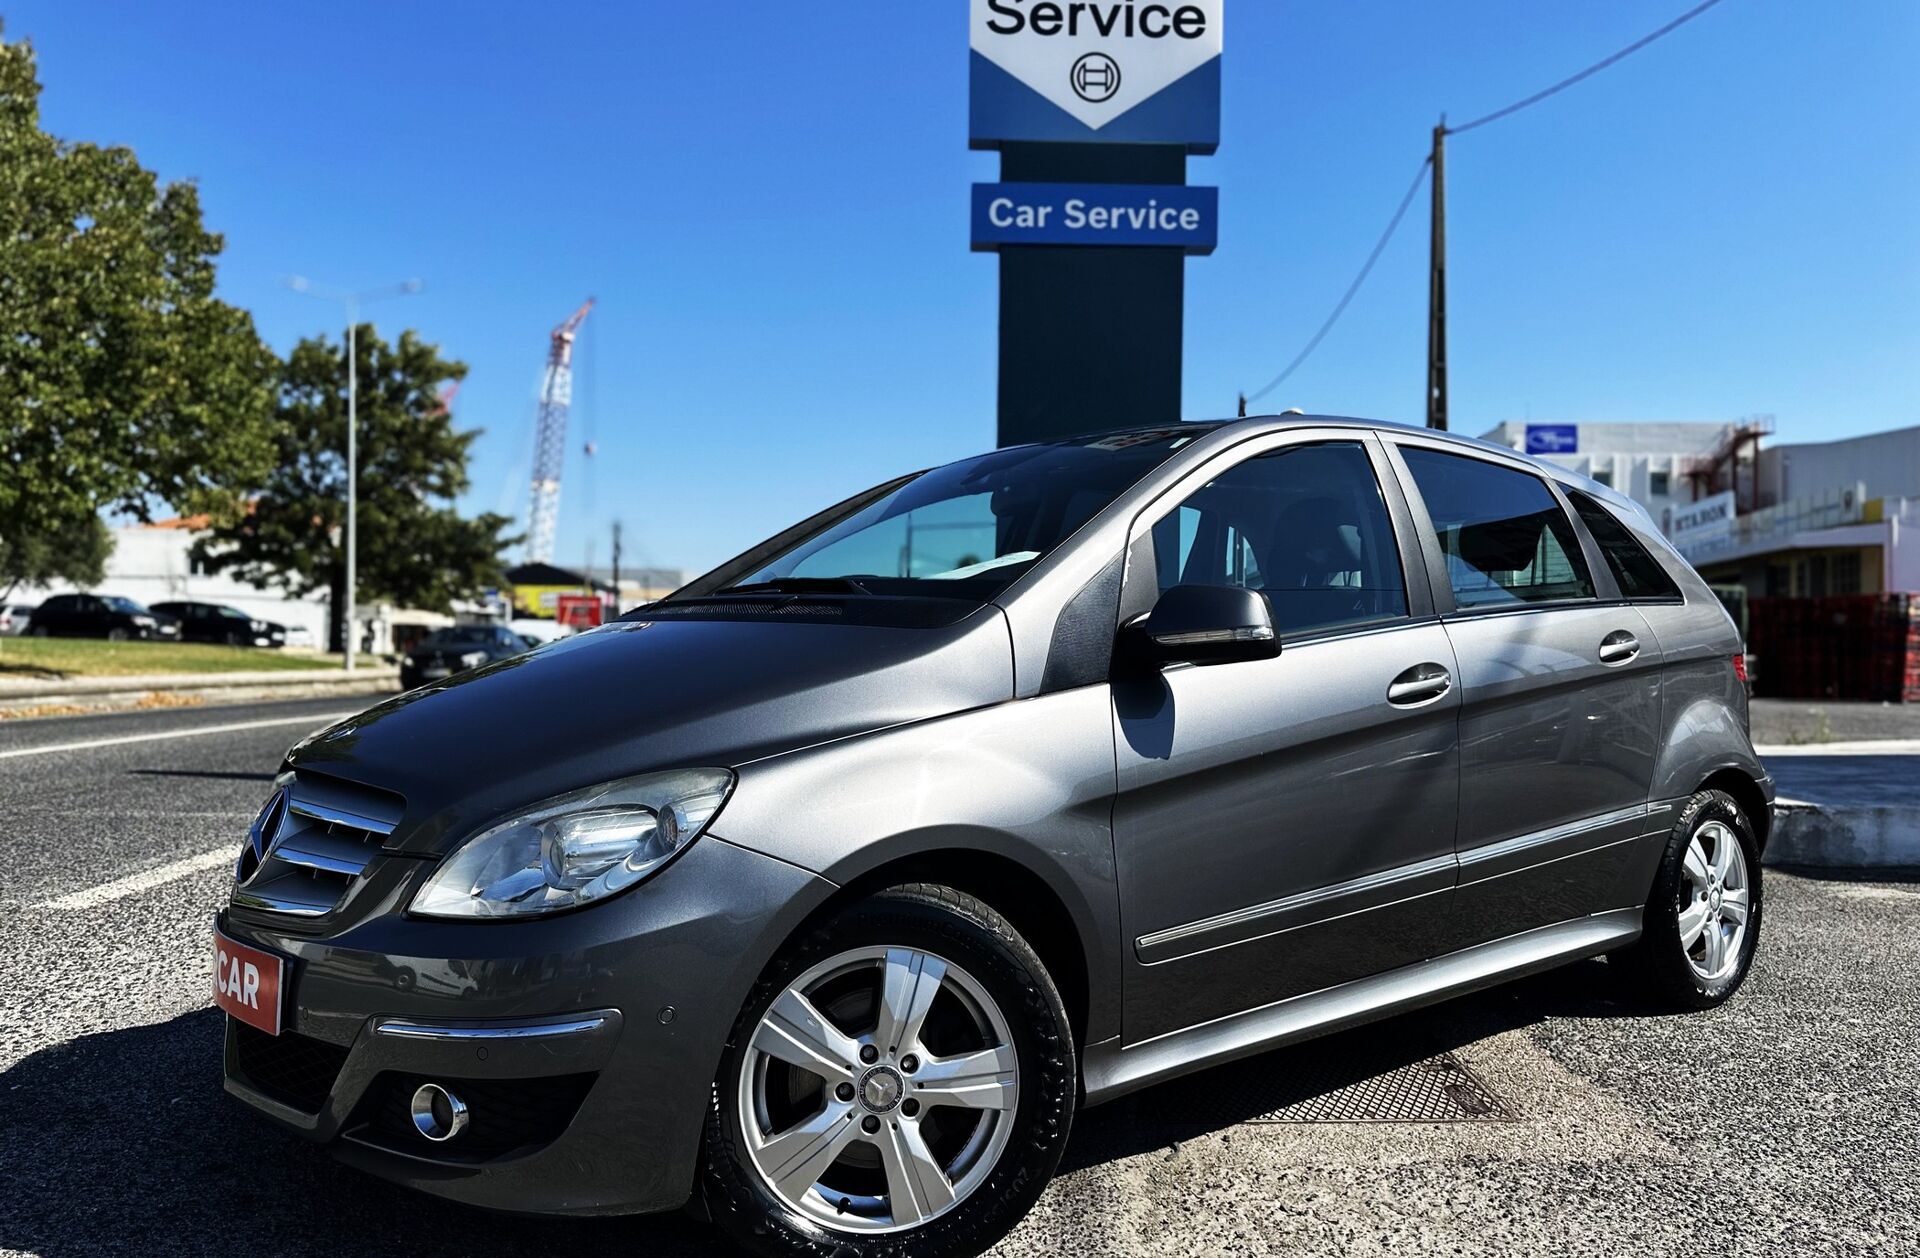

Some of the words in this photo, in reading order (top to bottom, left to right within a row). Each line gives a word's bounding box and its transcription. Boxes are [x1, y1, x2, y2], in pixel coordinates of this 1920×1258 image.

[986, 0, 1206, 39] Service
[989, 198, 1052, 228] Car
[1064, 199, 1200, 230] Service
[218, 950, 259, 1010] CAR
